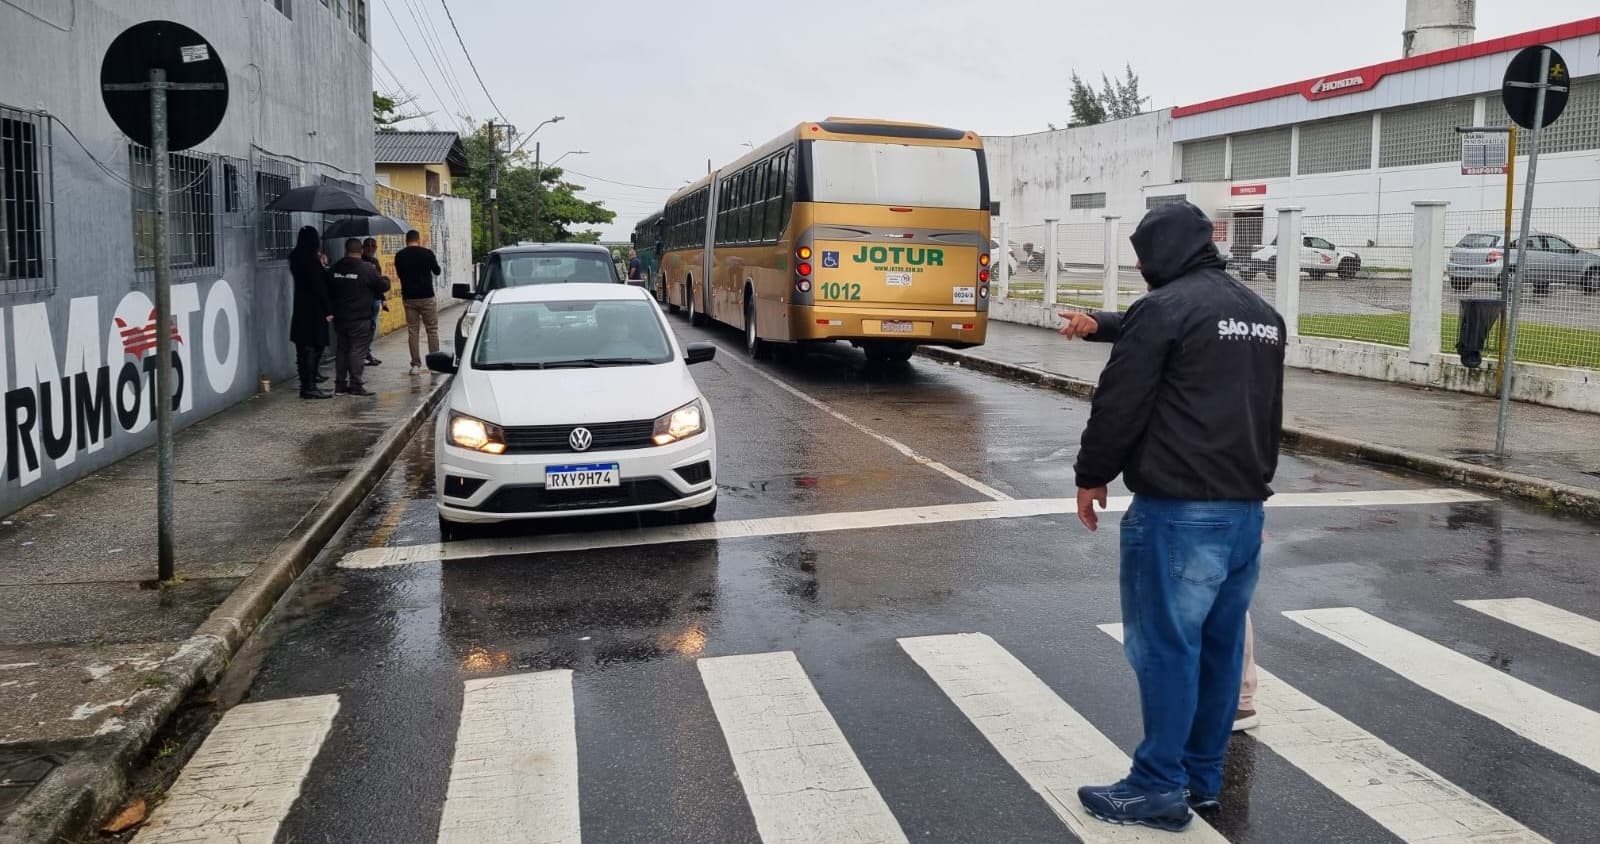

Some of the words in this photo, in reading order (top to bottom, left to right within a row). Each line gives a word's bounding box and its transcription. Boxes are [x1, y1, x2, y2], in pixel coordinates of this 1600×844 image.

[1321, 76, 1364, 92] HONDA
[852, 245, 944, 266] JOTUR
[821, 282, 861, 300] 1012
[1217, 318, 1249, 335] SÃO
[0, 280, 240, 487] MOTO
[552, 471, 611, 487] RXY9H74
